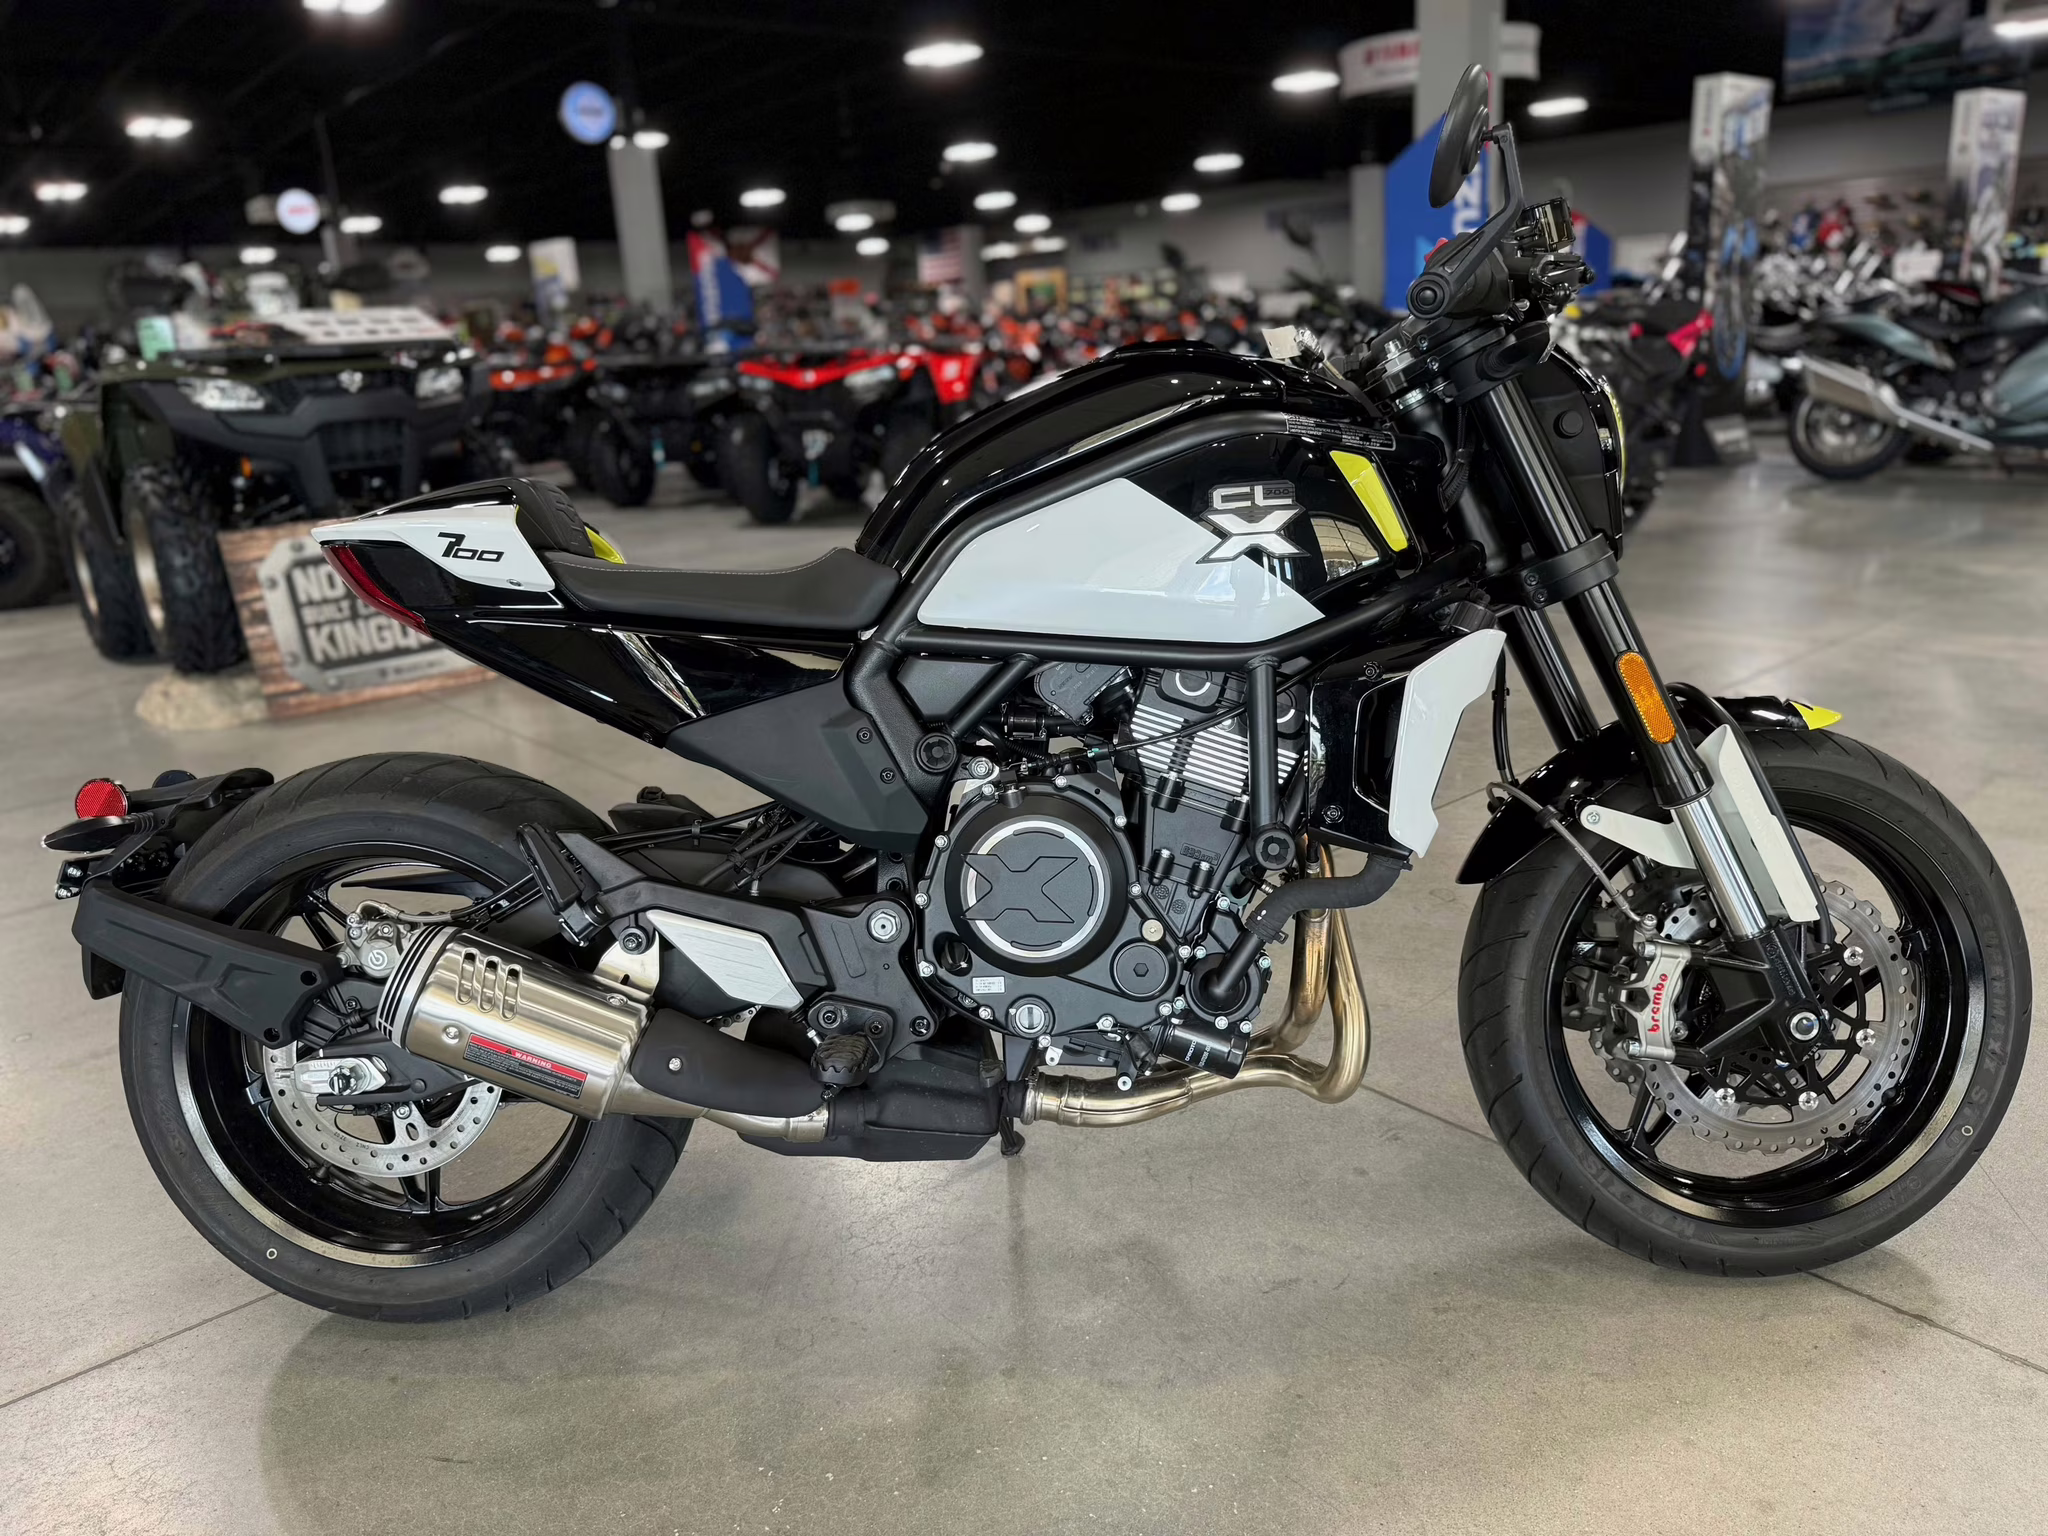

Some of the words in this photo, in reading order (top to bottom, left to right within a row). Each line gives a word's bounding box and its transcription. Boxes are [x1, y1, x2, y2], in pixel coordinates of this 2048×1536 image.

[1213, 485, 1293, 509] CL
[437, 532, 505, 562] 700
[1647, 973, 1669, 1034] brembo
[514, 1051, 553, 1069] WARNING
